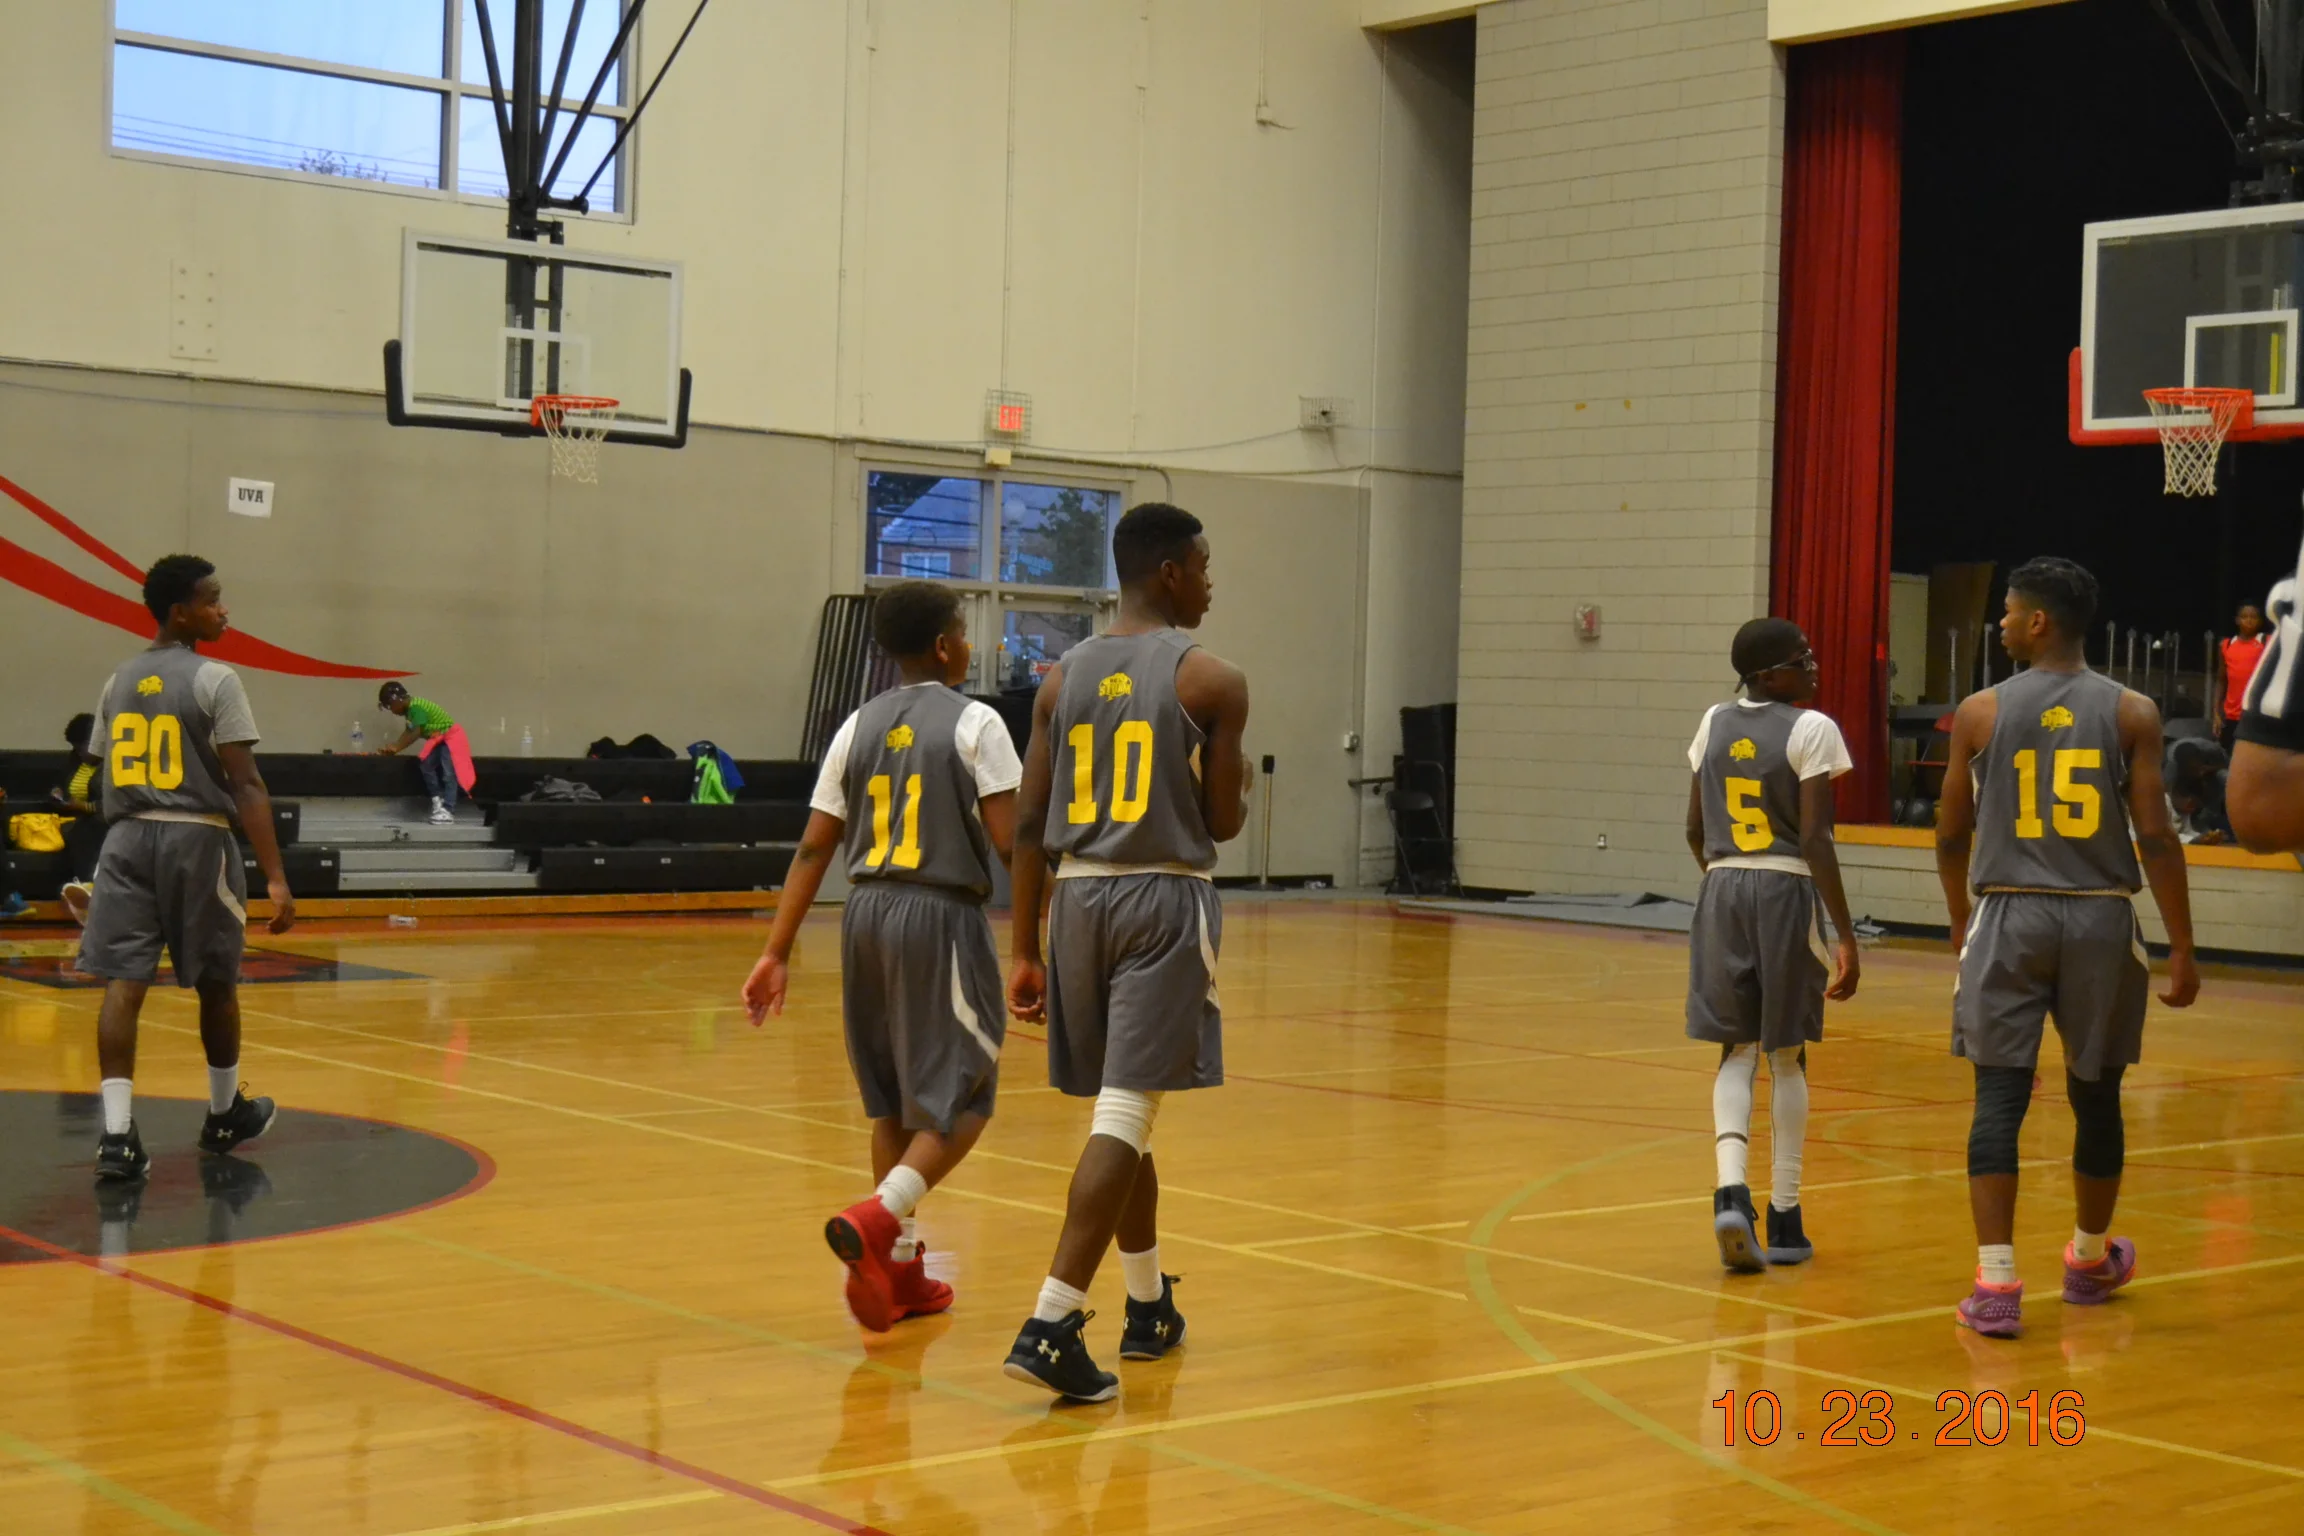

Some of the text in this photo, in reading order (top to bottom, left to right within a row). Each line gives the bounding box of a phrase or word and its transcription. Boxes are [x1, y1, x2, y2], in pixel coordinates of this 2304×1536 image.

[999, 405, 1025, 431] EXIT
[238, 487, 264, 504] UVA
[111, 712, 183, 788] 20
[1068, 721, 1153, 824] 10
[866, 774, 922, 869] 11
[1726, 777, 1773, 852] 5
[2013, 749, 2102, 839] 15
